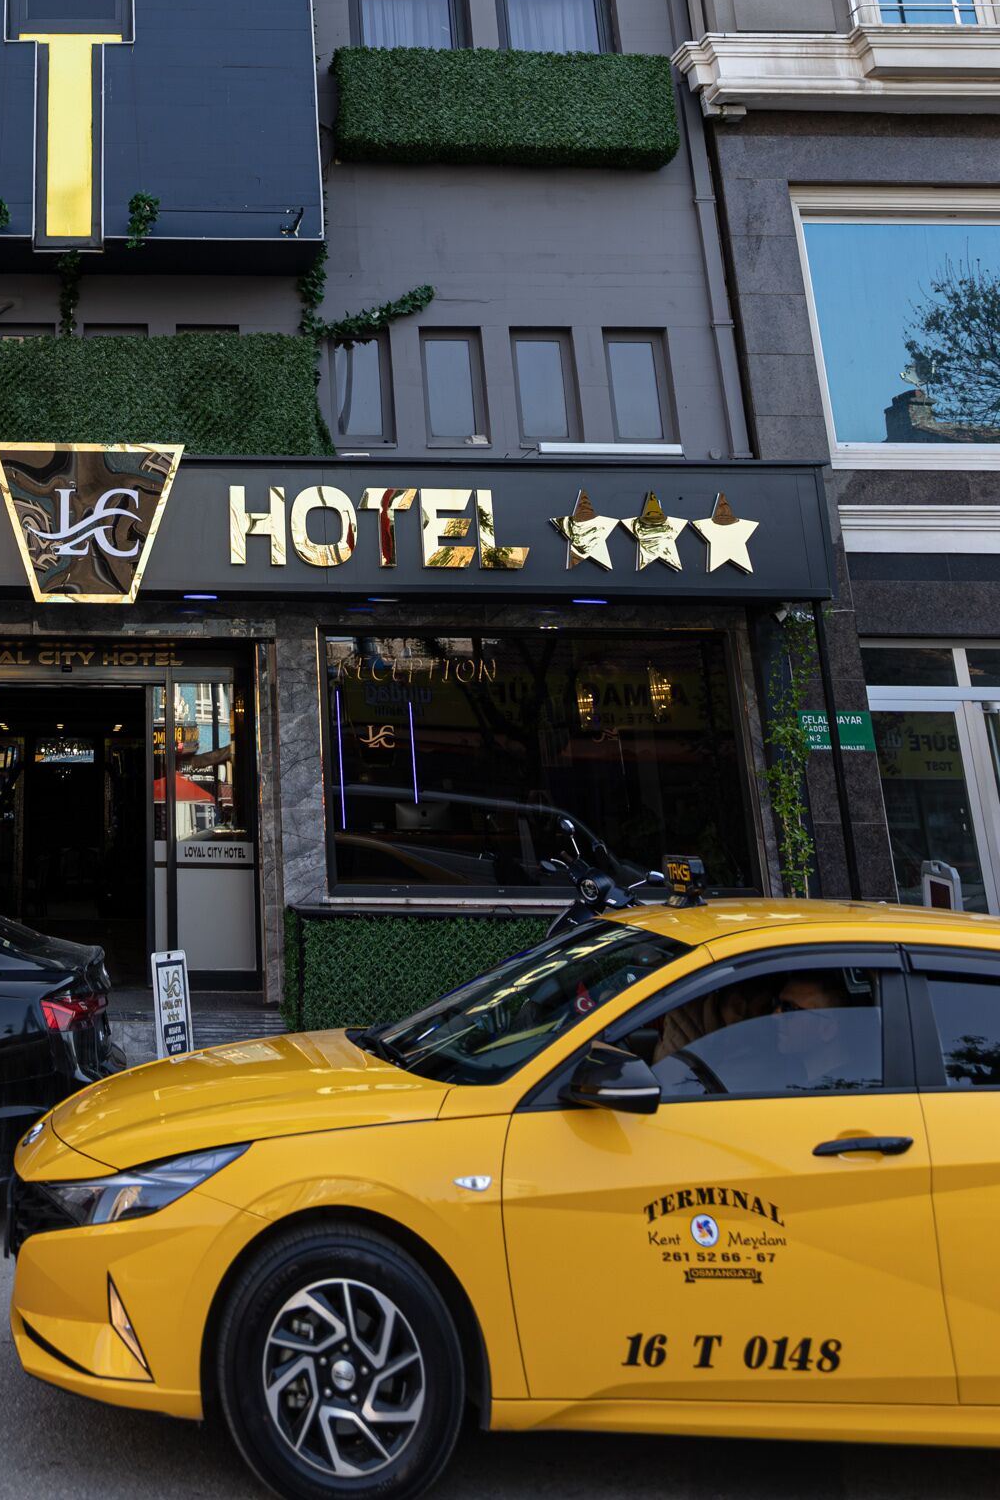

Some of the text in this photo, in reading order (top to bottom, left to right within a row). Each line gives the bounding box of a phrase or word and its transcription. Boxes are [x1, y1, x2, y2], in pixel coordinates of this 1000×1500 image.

[228, 484, 532, 570] HOTEL
[38, 650, 96, 665] CITY
[102, 651, 185, 666] HOTEL
[802, 715, 829, 725] CELAL
[184, 846, 246, 859] LOYAL CITY HOTEL
[647, 1231, 787, 1250] Kent Meydanı
[662, 1251, 690, 1262] 261
[697, 1252, 717, 1262] 52
[721, 1252, 741, 1262] 66
[756, 1252, 776, 1263] 67
[621, 1332, 843, 1373] 16 T 0148
